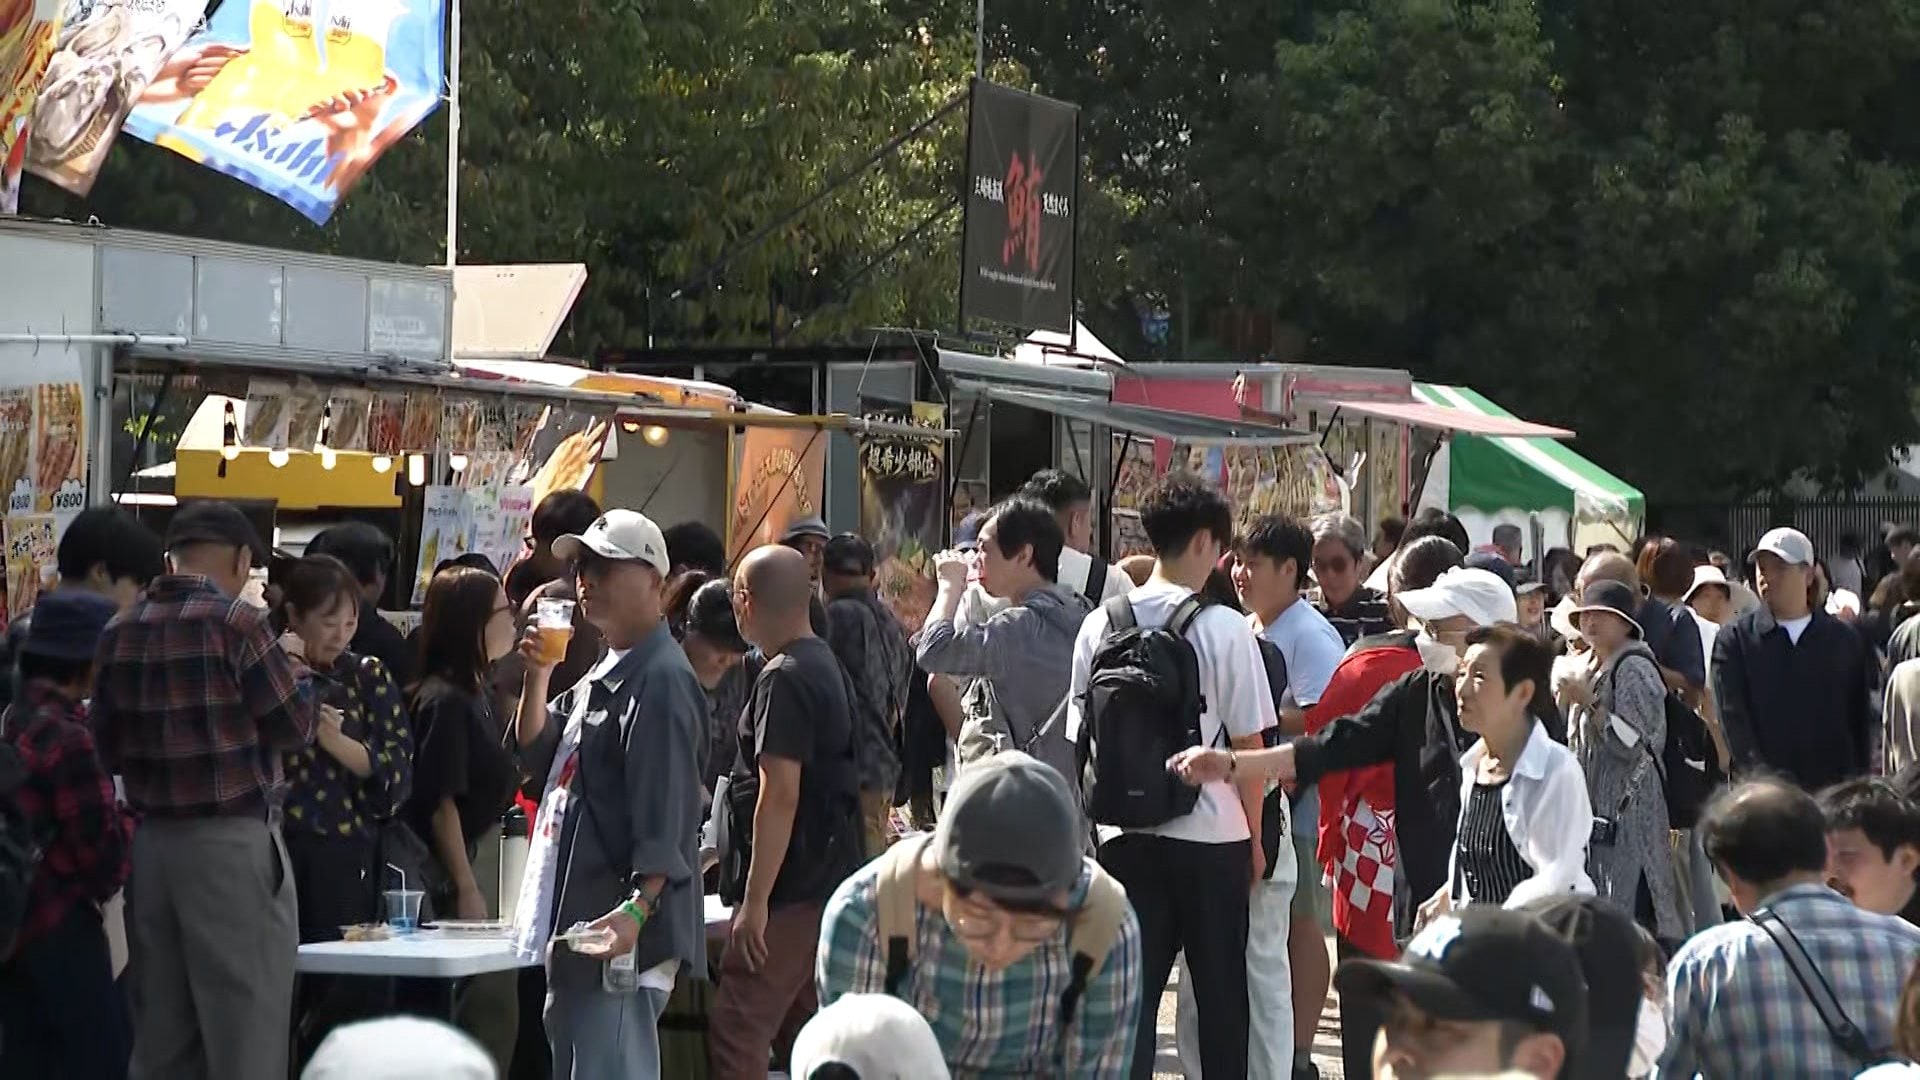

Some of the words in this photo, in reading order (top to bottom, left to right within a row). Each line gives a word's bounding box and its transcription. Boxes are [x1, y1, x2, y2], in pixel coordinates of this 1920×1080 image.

[214, 113, 347, 186] Asahi
[867, 443, 937, 480] 超希少部位
[56, 493, 83, 509] ¥800
